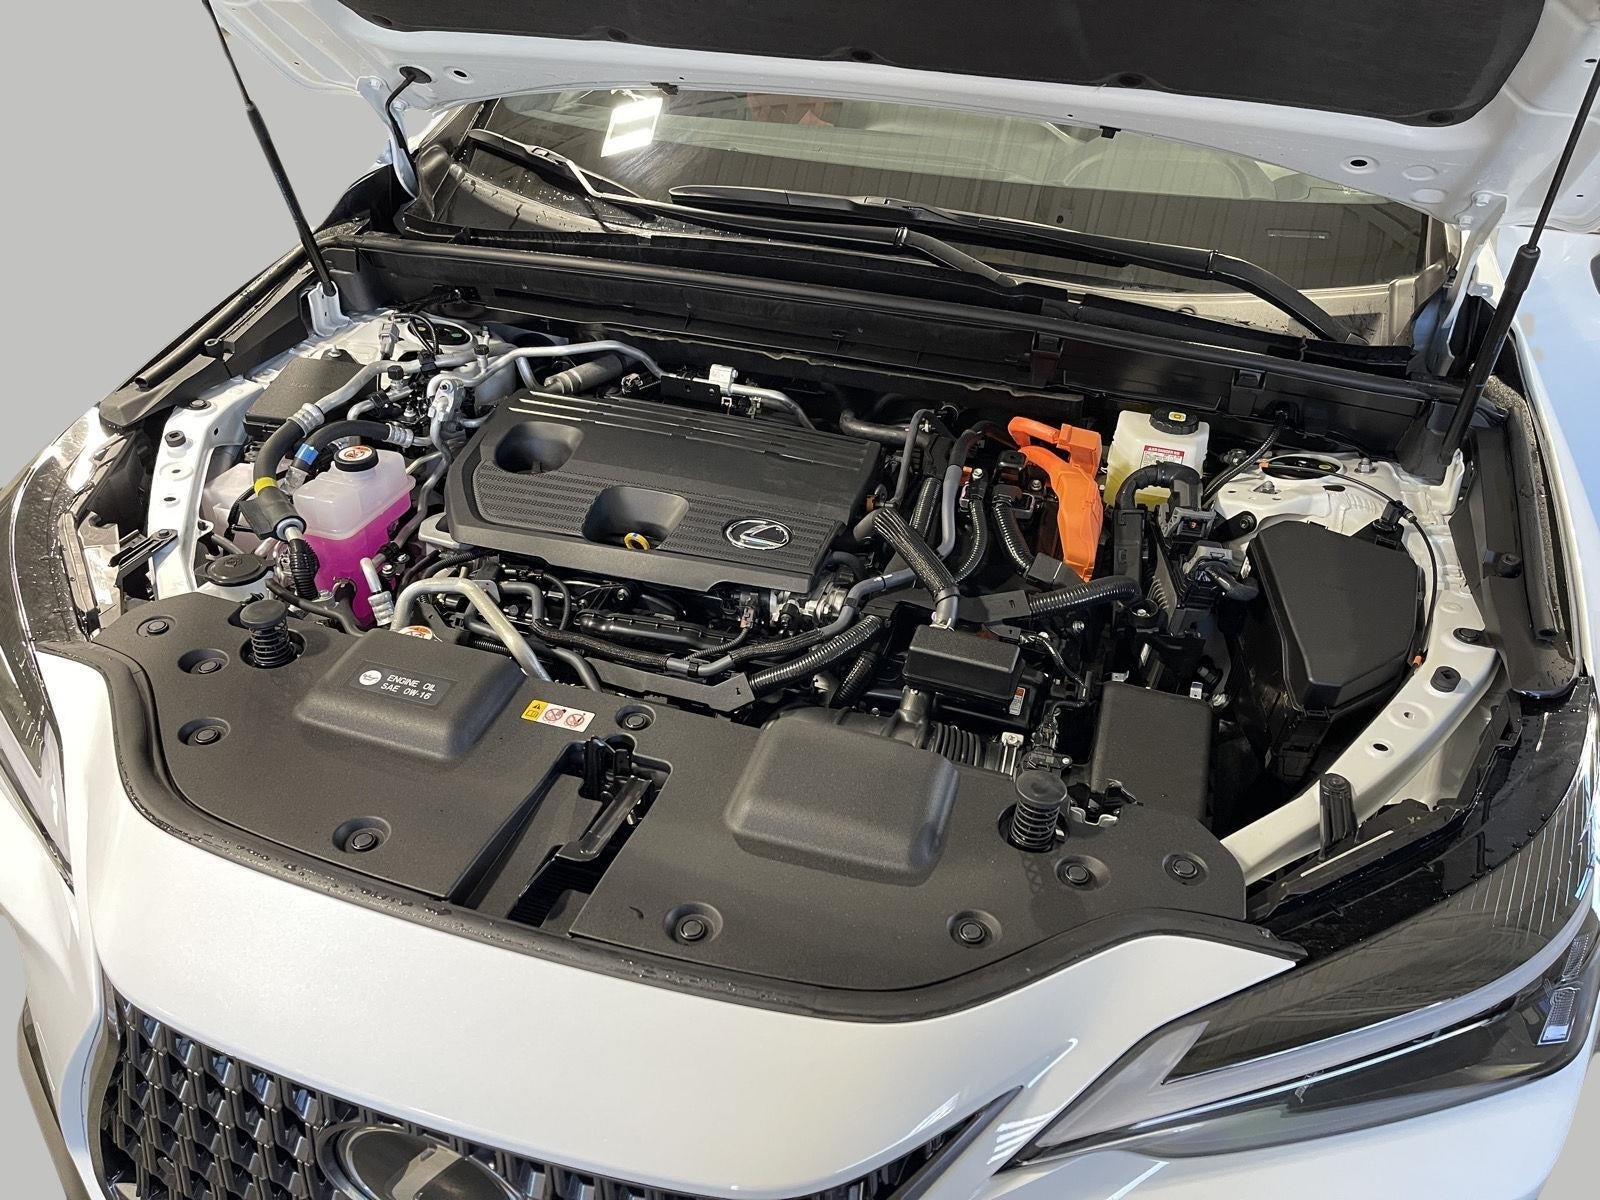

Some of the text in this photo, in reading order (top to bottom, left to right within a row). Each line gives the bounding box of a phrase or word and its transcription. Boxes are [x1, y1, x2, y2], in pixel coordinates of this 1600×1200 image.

[380, 682, 432, 700] SAE 0W-16
[386, 674, 436, 692] ENGINE OIL
